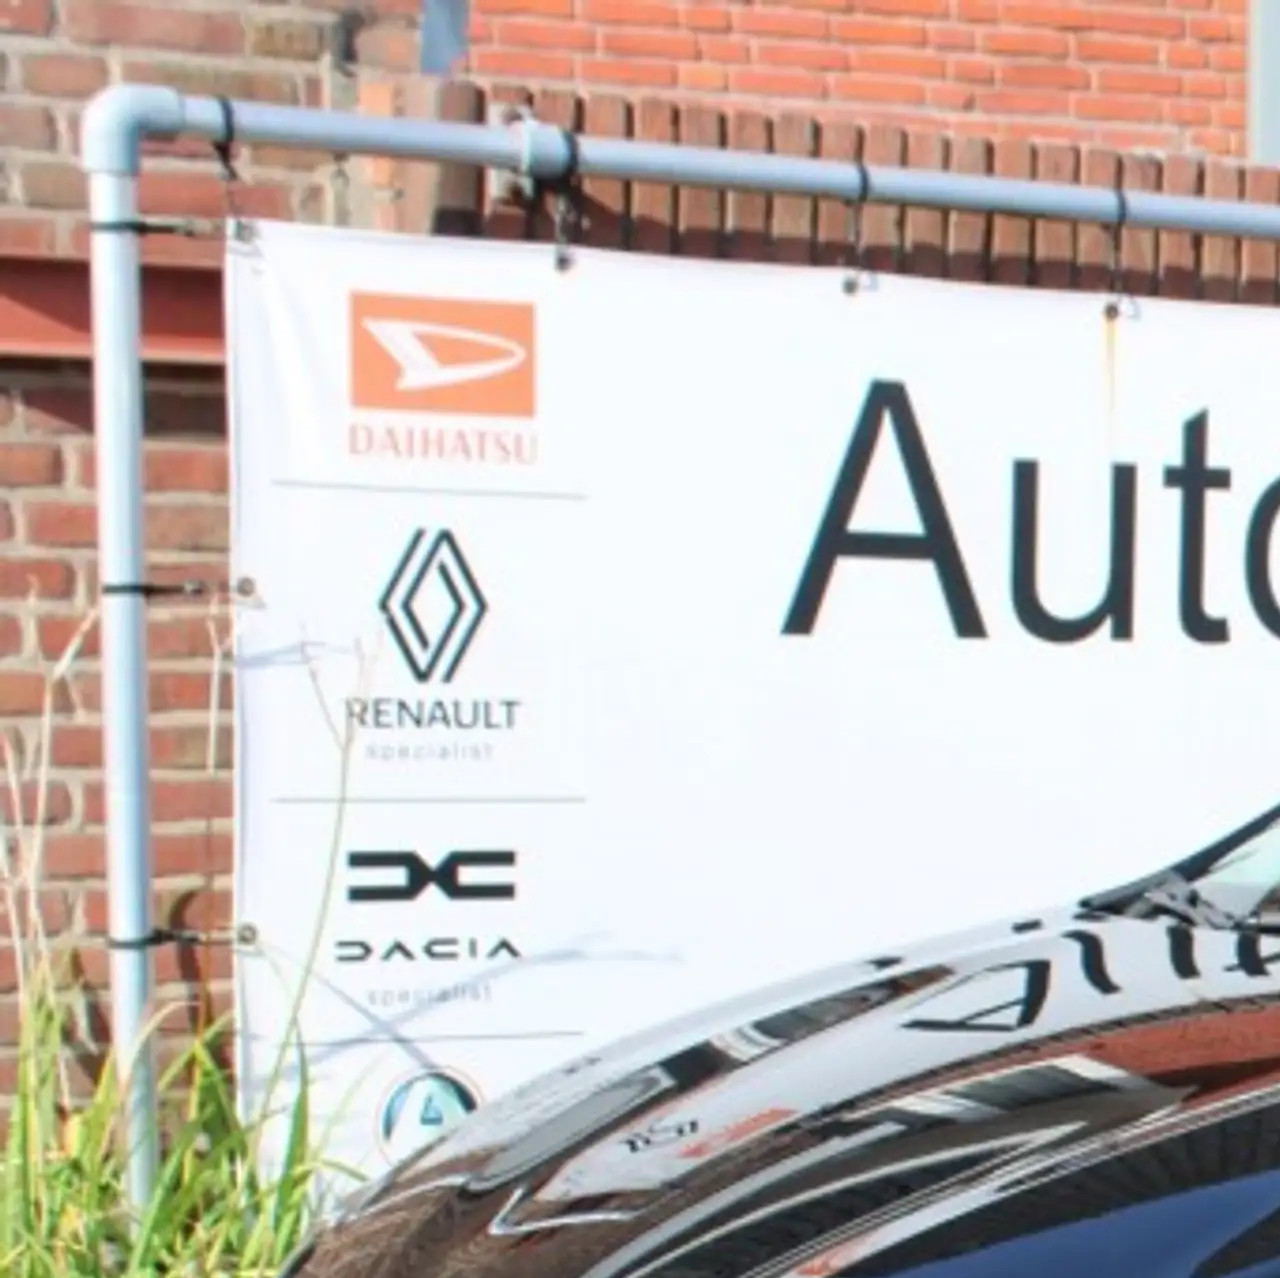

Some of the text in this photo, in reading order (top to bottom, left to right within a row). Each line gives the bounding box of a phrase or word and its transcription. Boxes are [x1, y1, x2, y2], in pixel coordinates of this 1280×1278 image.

[348, 423, 538, 464] DAIHATSU
[345, 697, 521, 730] RENAULT
[365, 741, 494, 762] specialist
[335, 937, 522, 963] DACIA
